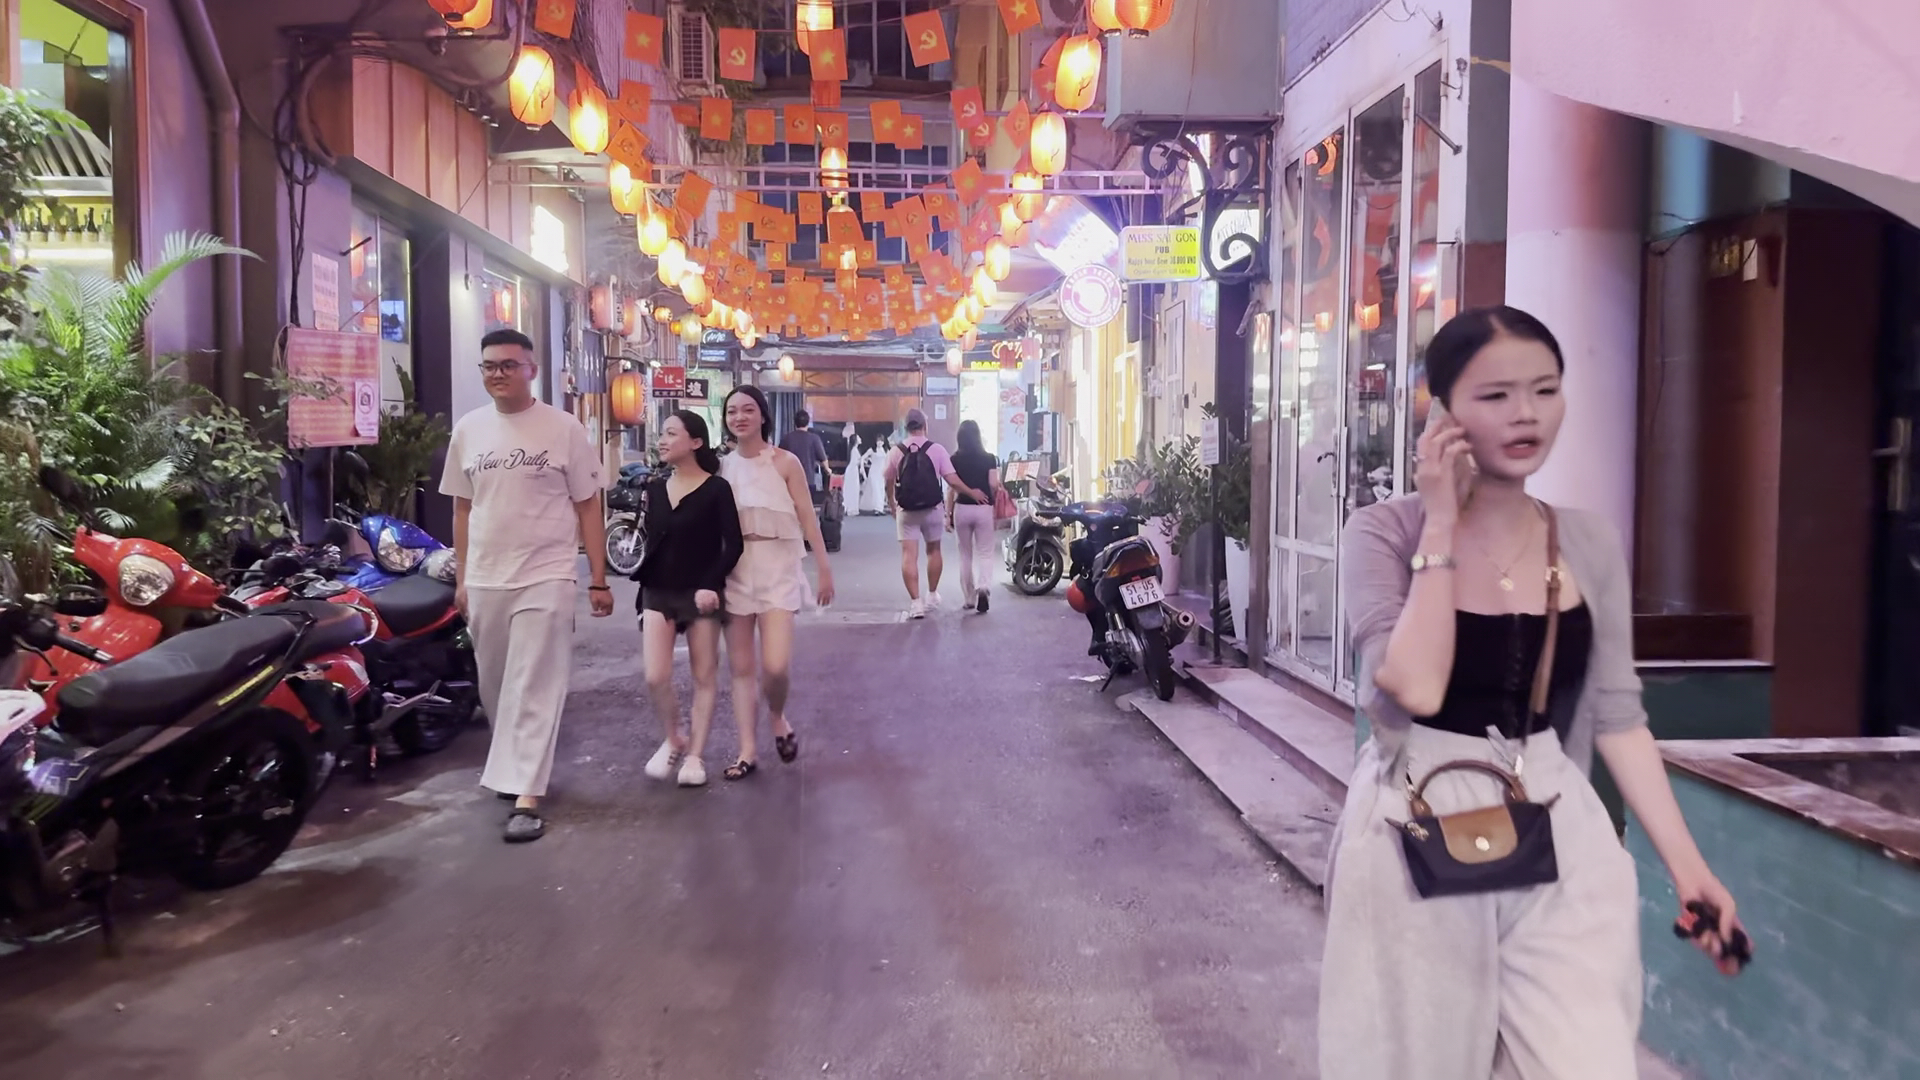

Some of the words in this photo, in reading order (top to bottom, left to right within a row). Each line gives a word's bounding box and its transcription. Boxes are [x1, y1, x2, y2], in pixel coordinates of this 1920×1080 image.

[1127, 233, 1153, 243] MISS
[1175, 232, 1197, 243] GON
[1154, 246, 1170, 254] PUB
[471, 451, 502, 476] New
[503, 448, 550, 471] Daily.
[1131, 590, 1159, 605] 4676
